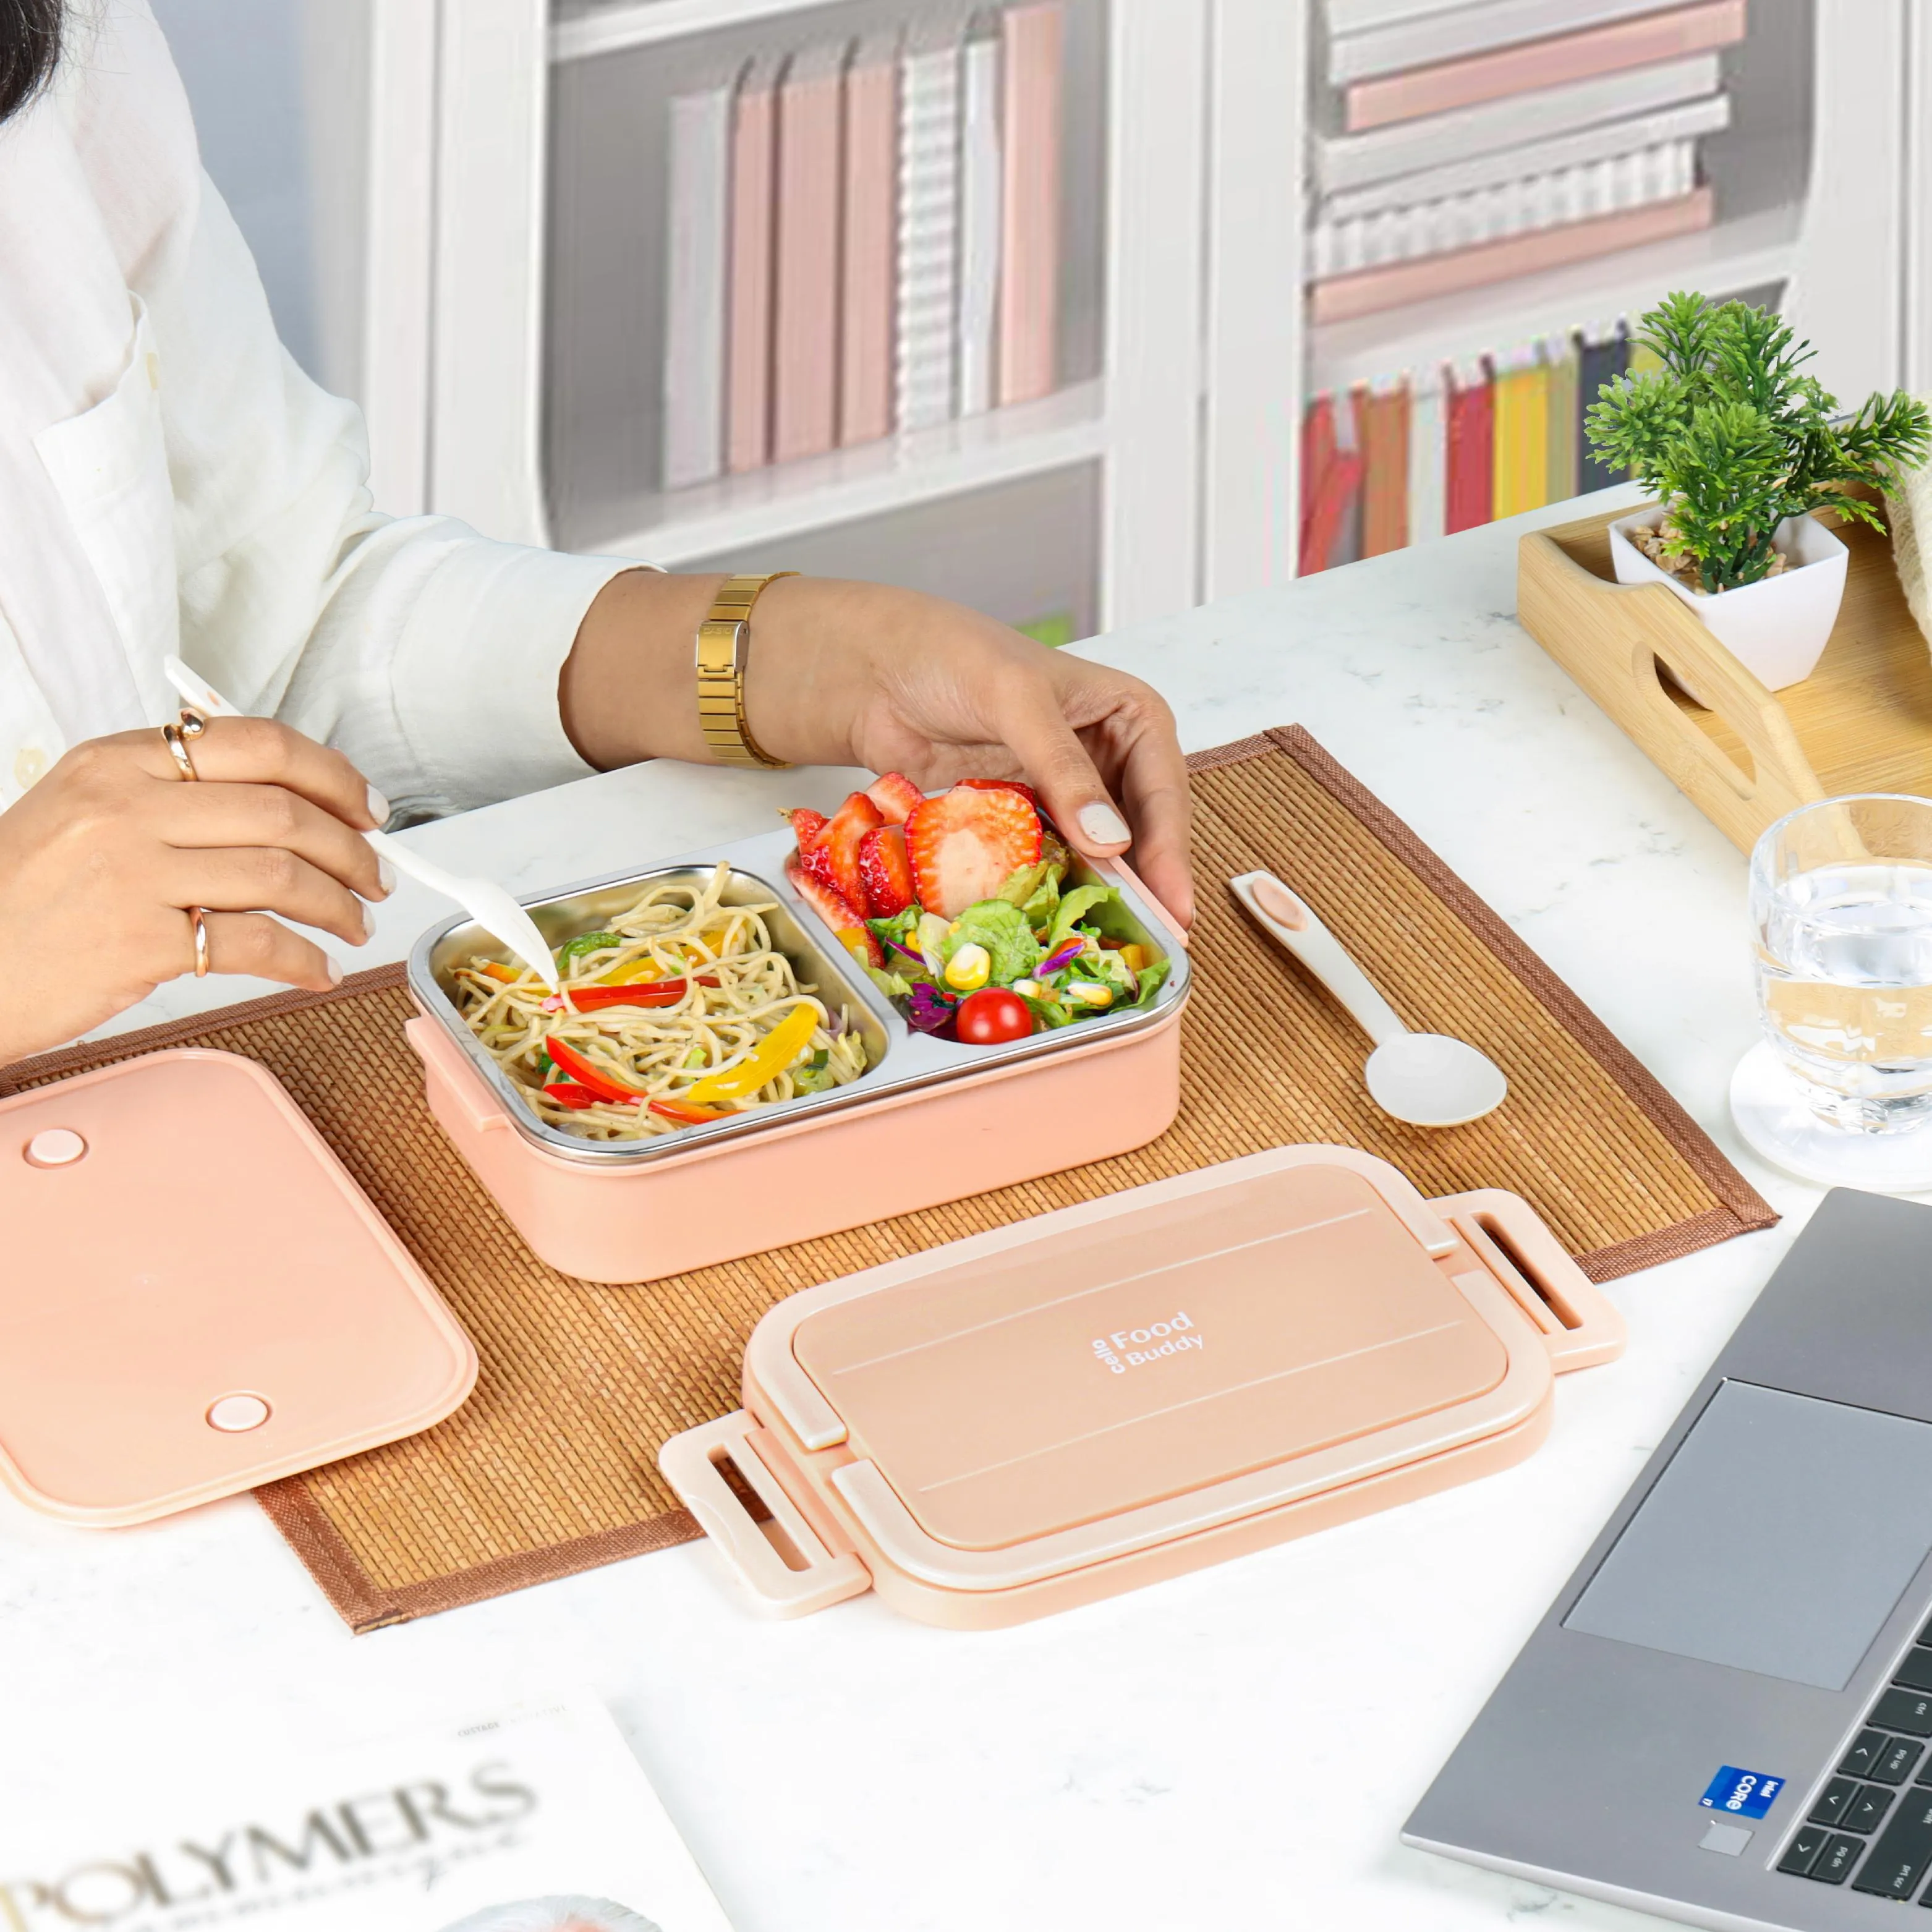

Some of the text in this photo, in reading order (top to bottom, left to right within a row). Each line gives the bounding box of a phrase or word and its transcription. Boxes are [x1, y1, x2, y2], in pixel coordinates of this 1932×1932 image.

[1110, 1311, 1194, 1349] Food
[1092, 1339, 1126, 1374] cello
[1125, 1335, 1202, 1366] Buddy
[1915, 1702, 1927, 1715] ctrl
